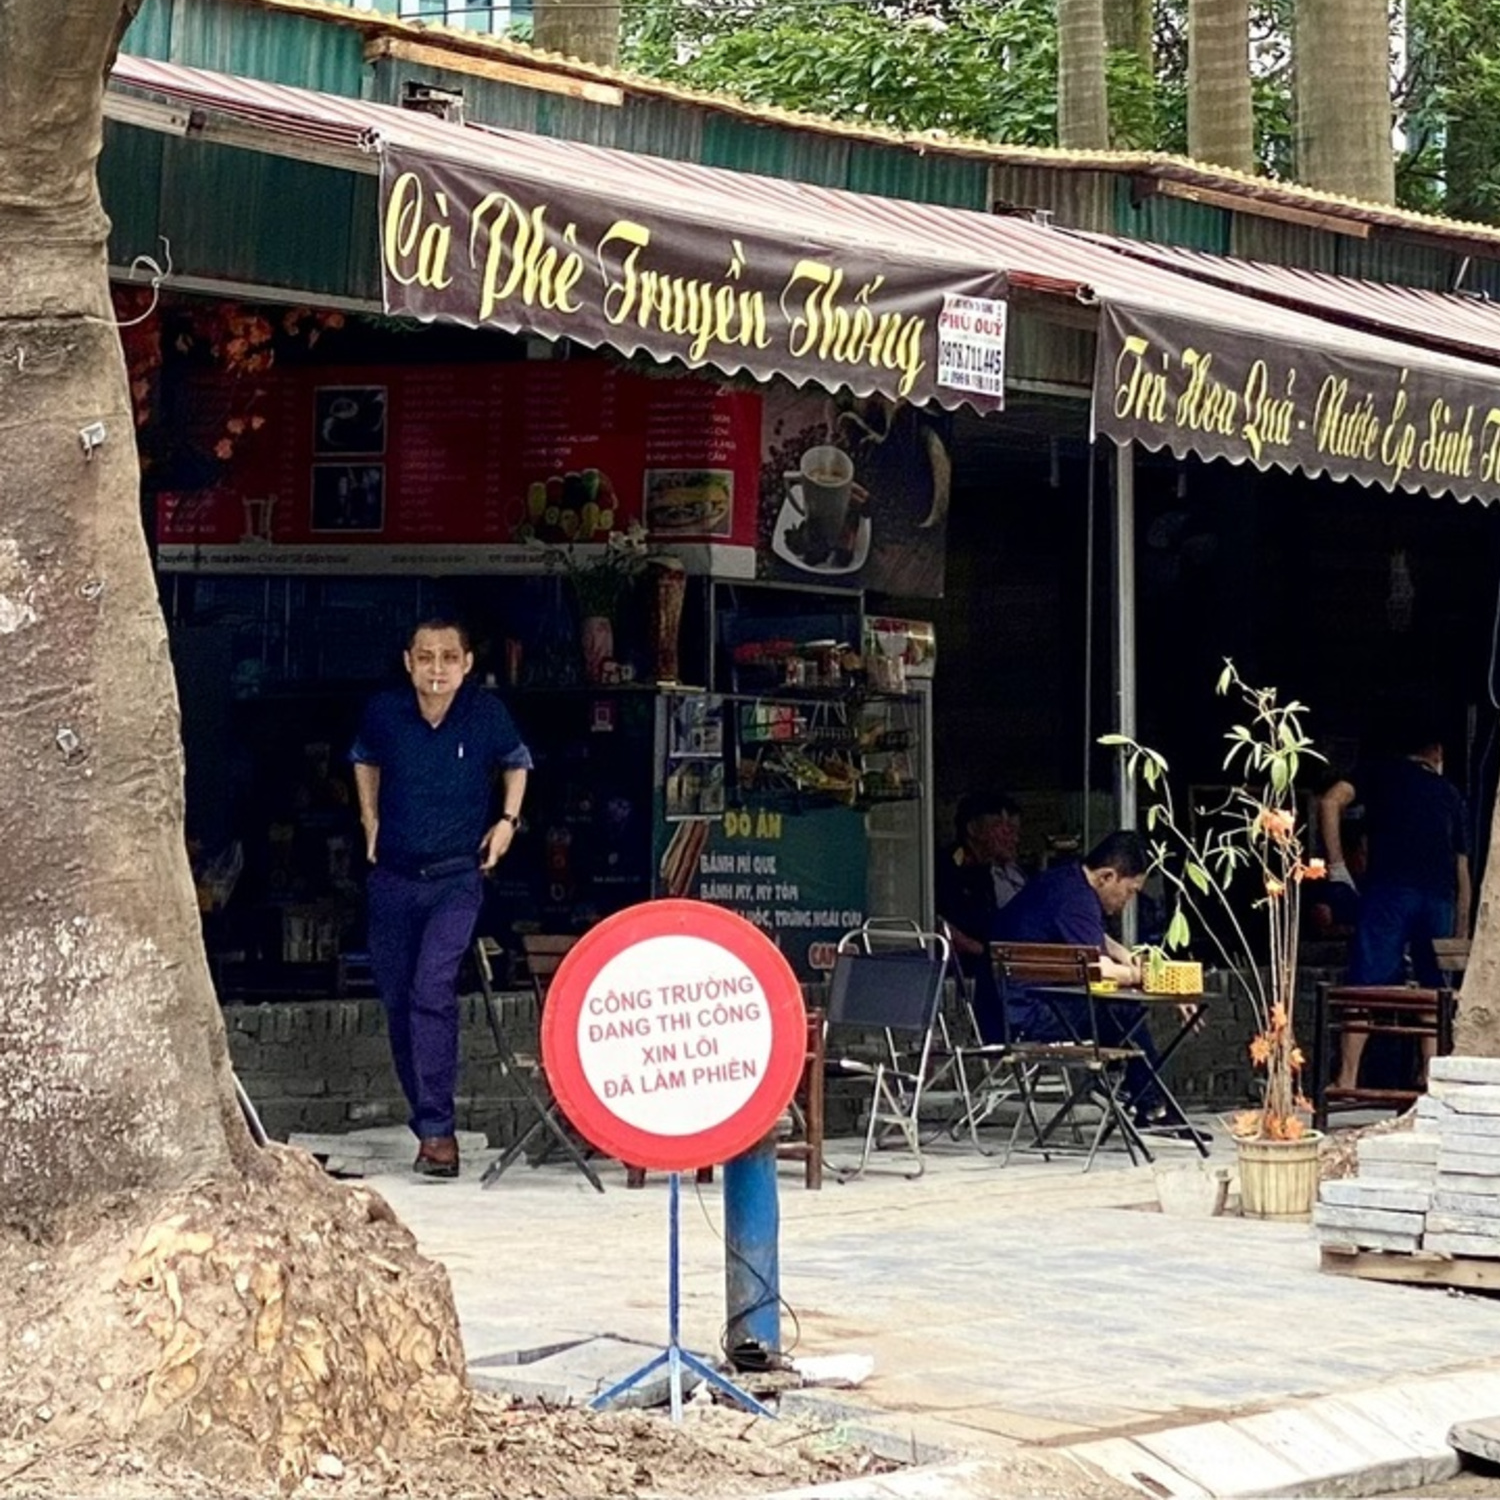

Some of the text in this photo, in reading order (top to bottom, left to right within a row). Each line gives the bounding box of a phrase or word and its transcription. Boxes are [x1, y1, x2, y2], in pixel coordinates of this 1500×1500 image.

[385, 172, 926, 396] Cà Phê Truyền Thống
[1115, 335, 1167, 423] Trà
[1176, 348, 1237, 435] Hoa
[1242, 360, 1295, 460] Quả
[1313, 375, 1379, 461] Nước
[1382, 368, 1416, 486] Ép
[1419, 398, 1473, 478] Sinh
[589, 975, 754, 1015] CÔNG TRƯỜNG
[589, 1003, 761, 1043] ĐANG THI CÔNG
[642, 1043, 677, 1066] XIN
[604, 1074, 634, 1098] ĐÃ
[641, 1069, 687, 1093] LÀM
